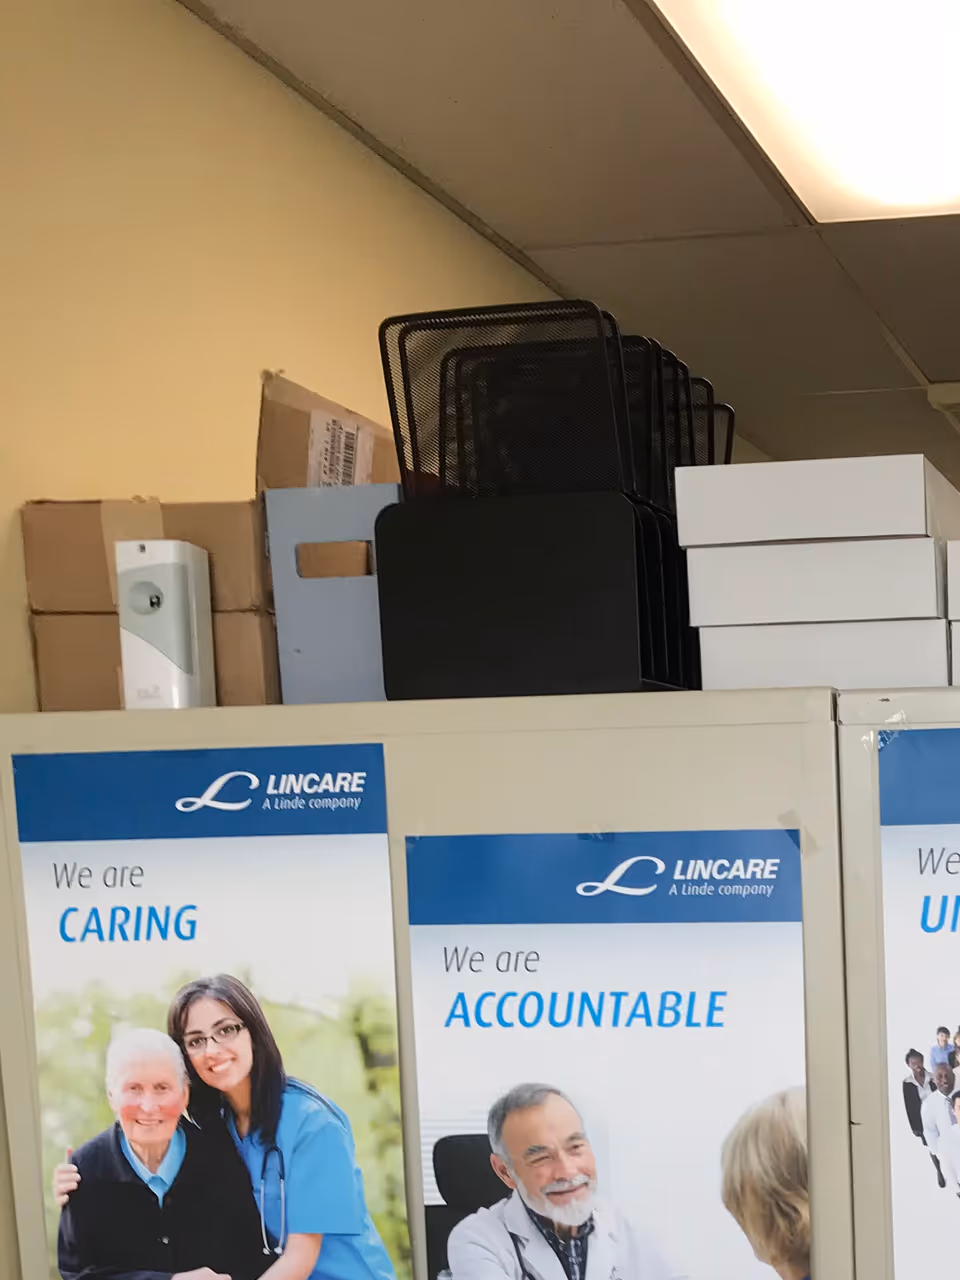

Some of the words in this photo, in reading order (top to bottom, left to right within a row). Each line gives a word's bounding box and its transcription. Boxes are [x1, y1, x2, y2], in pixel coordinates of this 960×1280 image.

[266, 772, 367, 795] LINCARE
[261, 797, 271, 810] A
[274, 796, 306, 810] Linde
[308, 797, 361, 812] company
[52, 862, 93, 889] We
[103, 865, 145, 888] are
[673, 859, 780, 880] LINCARE
[668, 884, 678, 896] A
[681, 883, 714, 896] Linde
[718, 884, 774, 899] company
[58, 904, 197, 943] CARING
[443, 945, 485, 973] We
[495, 950, 541, 973] are
[444, 991, 727, 1028] ACCOUNTABLE
